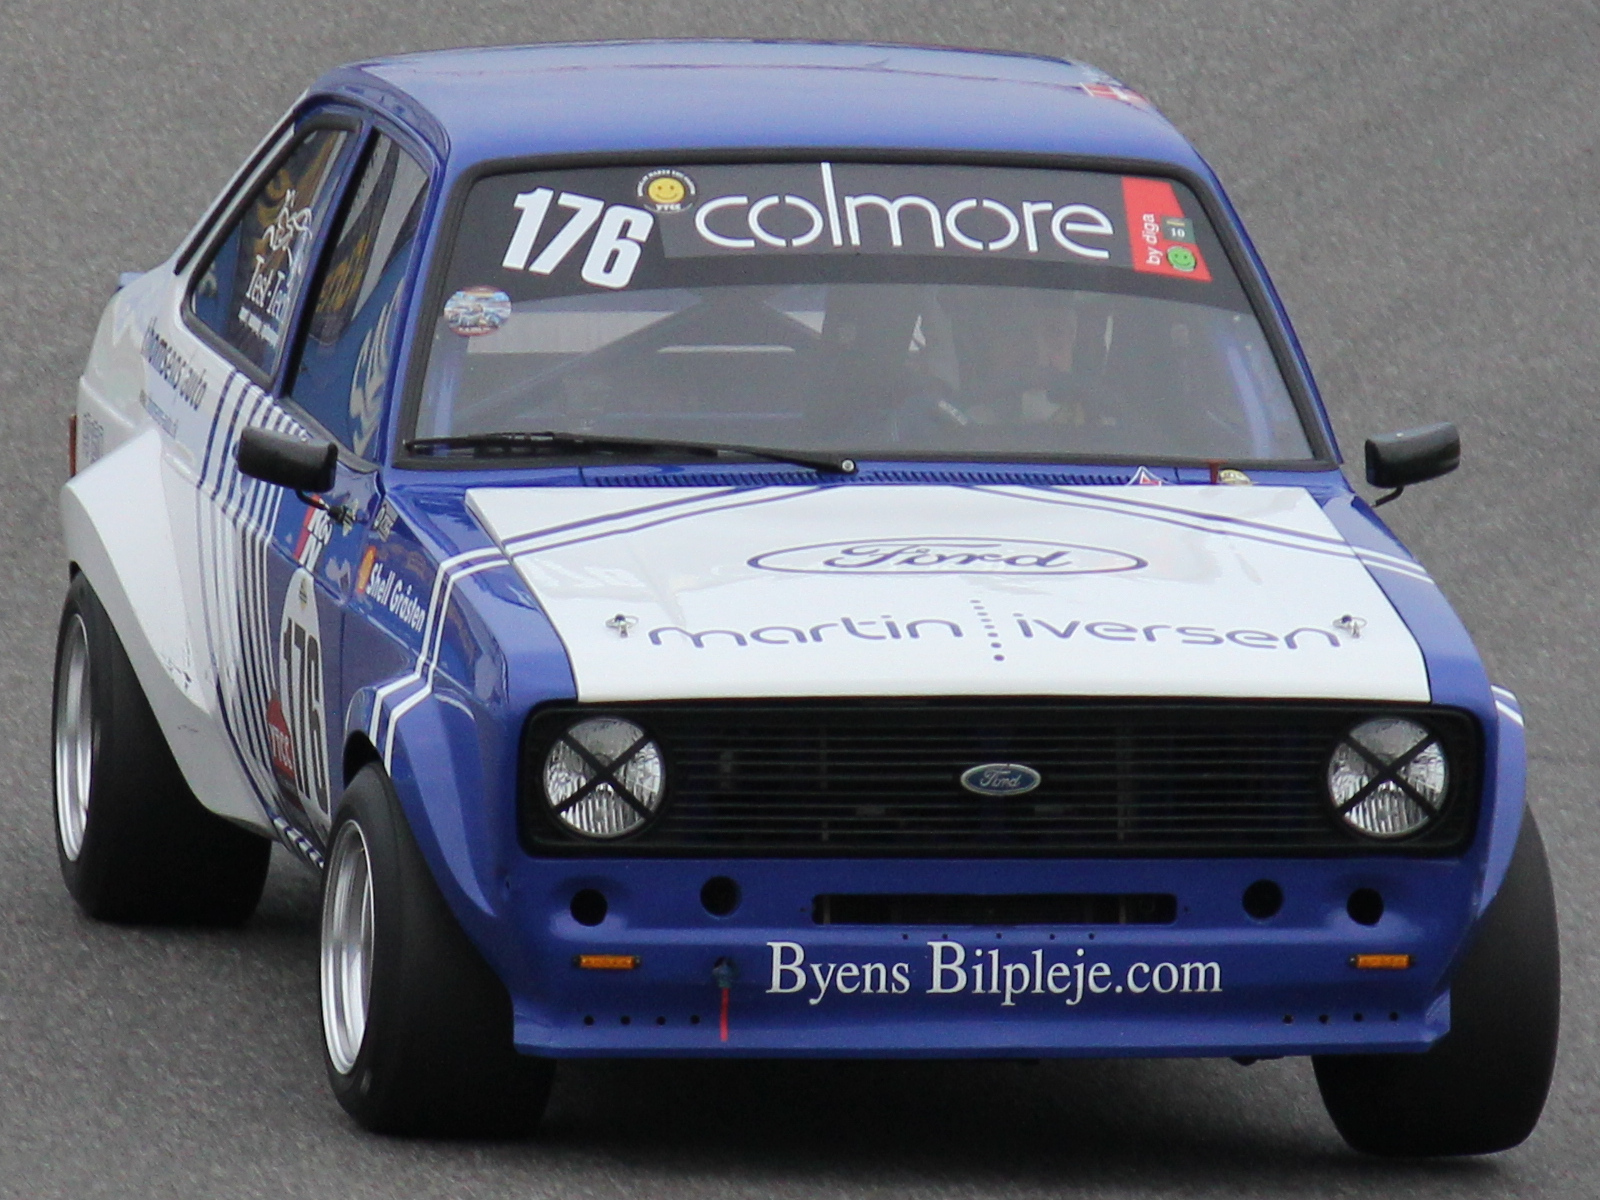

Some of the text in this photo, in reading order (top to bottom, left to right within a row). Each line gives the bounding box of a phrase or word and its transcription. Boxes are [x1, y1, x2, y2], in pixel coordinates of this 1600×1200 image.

[694, 161, 1114, 260] colmore
[502, 187, 654, 289] 176
[1142, 213, 1163, 265] by diga
[1171, 227, 1186, 238] 10
[823, 543, 1072, 568] Ford
[366, 562, 395, 605] Shell
[648, 612, 1341, 650] martin iversen
[980, 767, 1022, 788] Ford
[765, 941, 1223, 1006] Byens Bilpleje.com
